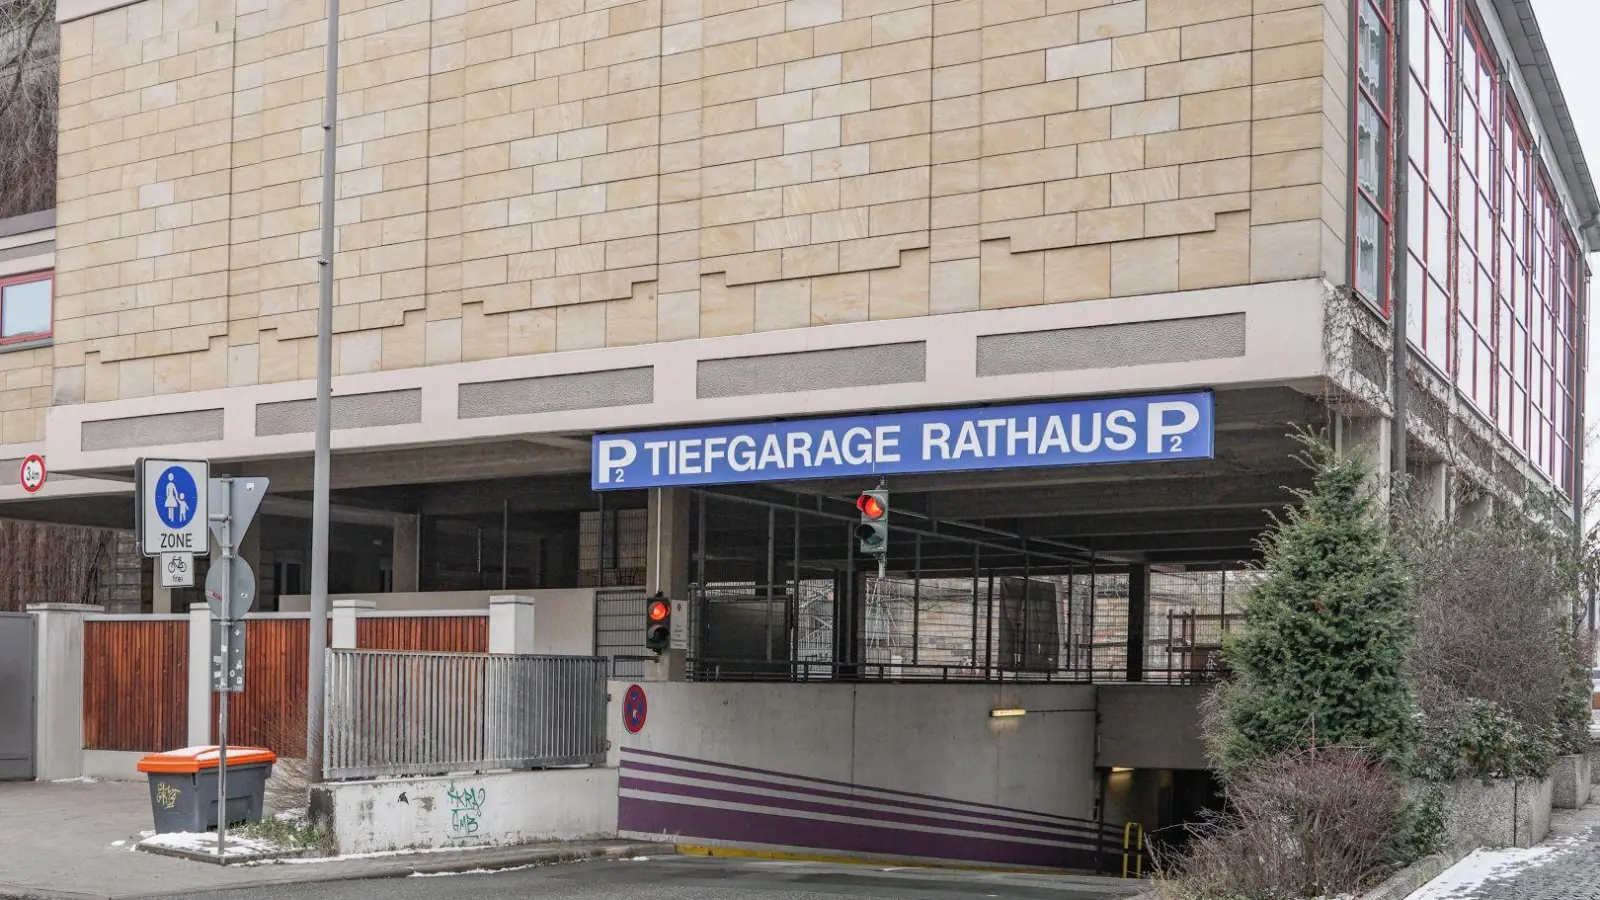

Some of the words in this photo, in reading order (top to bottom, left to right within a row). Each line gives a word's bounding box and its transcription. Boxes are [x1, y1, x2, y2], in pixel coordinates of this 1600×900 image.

[643, 425, 901, 476] TIEFGARAGE
[922, 409, 1137, 460] RATHAUS
[160, 533, 192, 548] ZONE
[172, 574, 184, 582] frei
